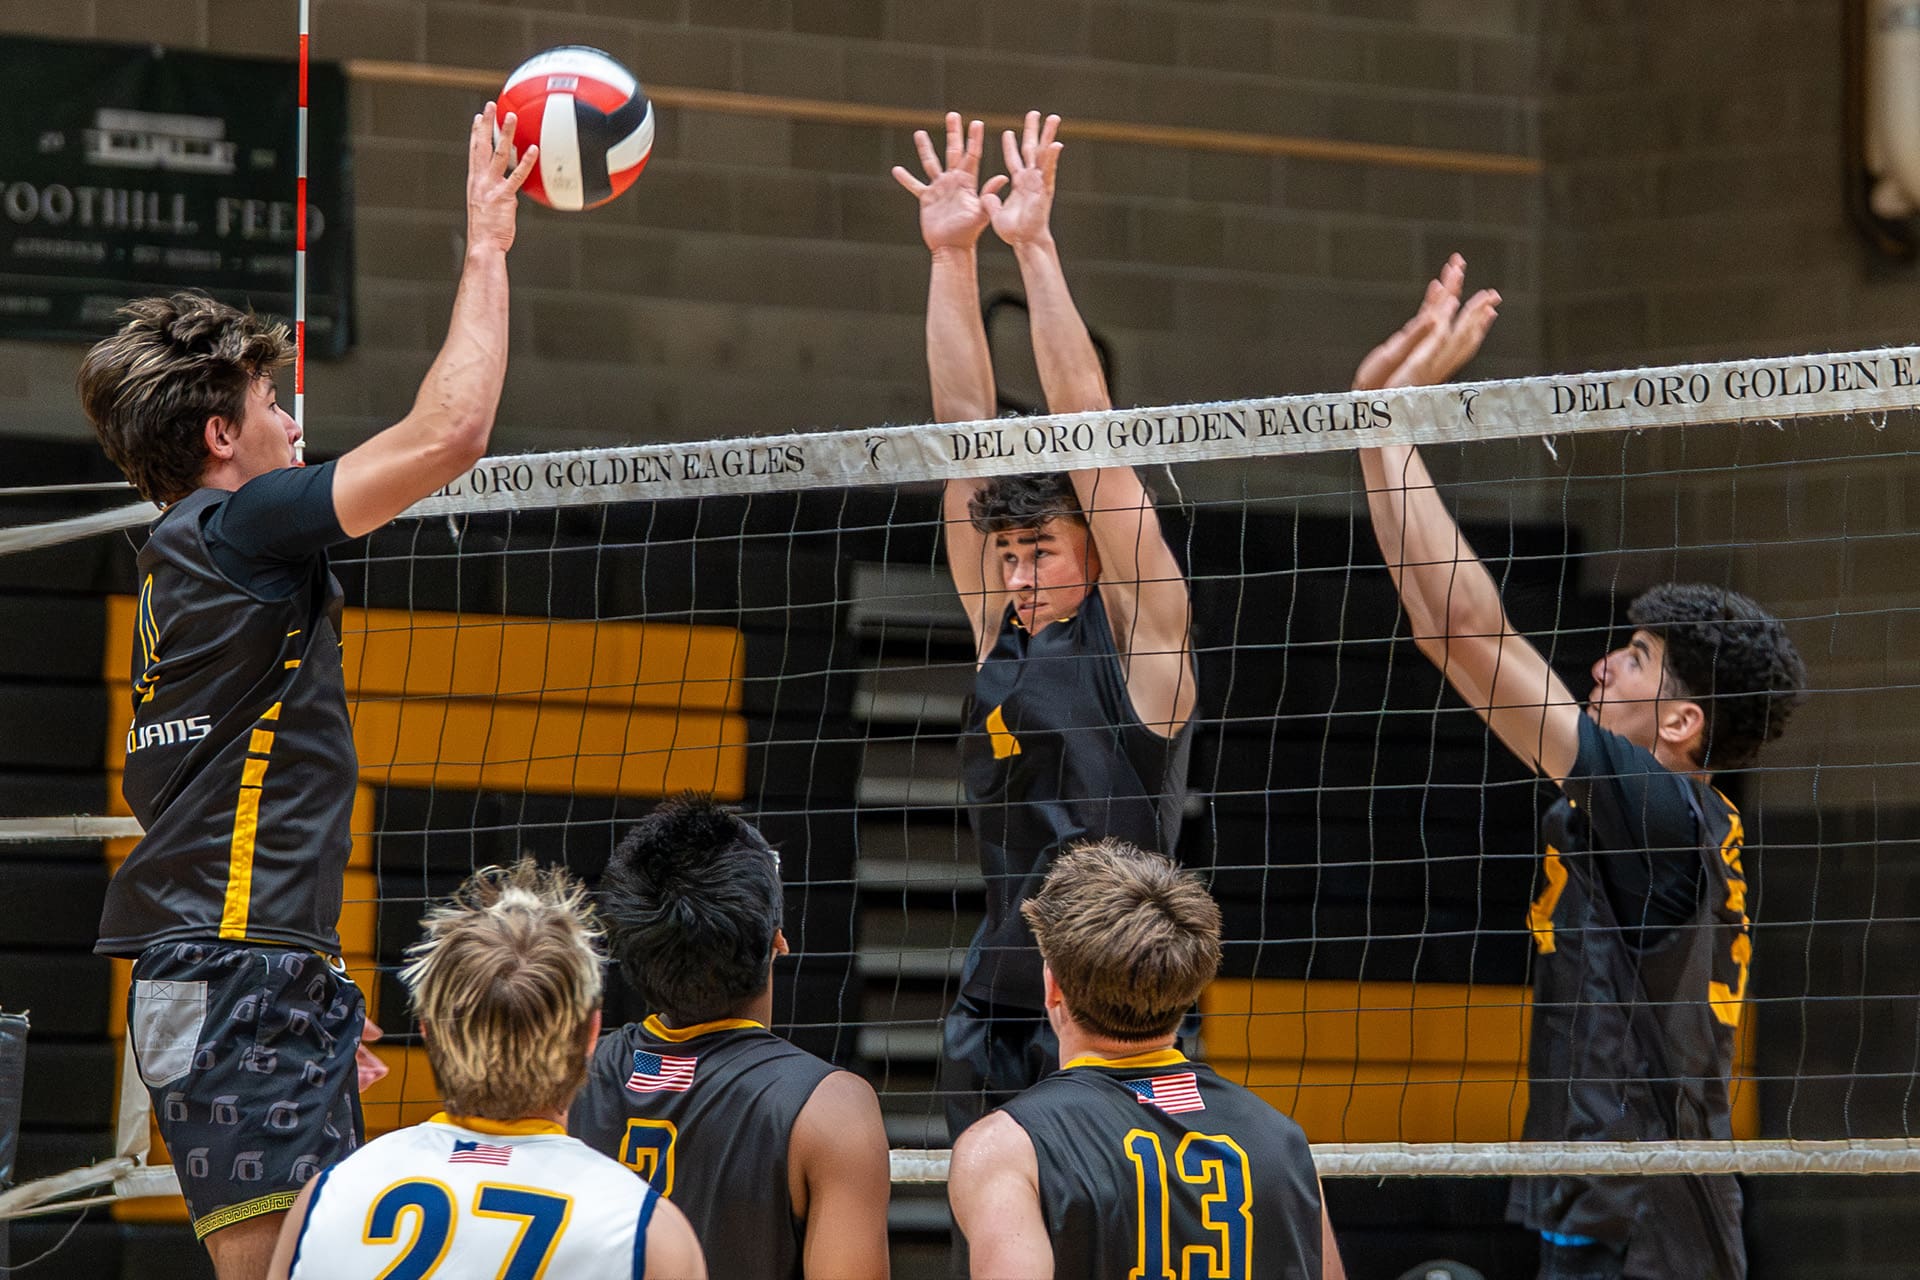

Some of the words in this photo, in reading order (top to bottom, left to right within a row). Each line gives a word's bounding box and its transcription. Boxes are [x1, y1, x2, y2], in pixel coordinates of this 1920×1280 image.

[0, 180, 199, 235] OOTHILL
[1550, 380, 1626, 415] DEL
[1633, 373, 1710, 407] ORO
[1725, 360, 1879, 399] GOLDEN
[1889, 357, 1920, 387] E
[949, 432, 1015, 461] DEL
[1024, 423, 1094, 455] ORO
[1107, 411, 1247, 449] GOLDEN
[1256, 400, 1394, 438] EAGLES
[470, 464, 533, 495] ORO
[545, 454, 673, 488] GOLDEN
[682, 446, 806, 480] EAGLES
[362, 1176, 574, 1280] 27
[1123, 1128, 1254, 1280] 13
